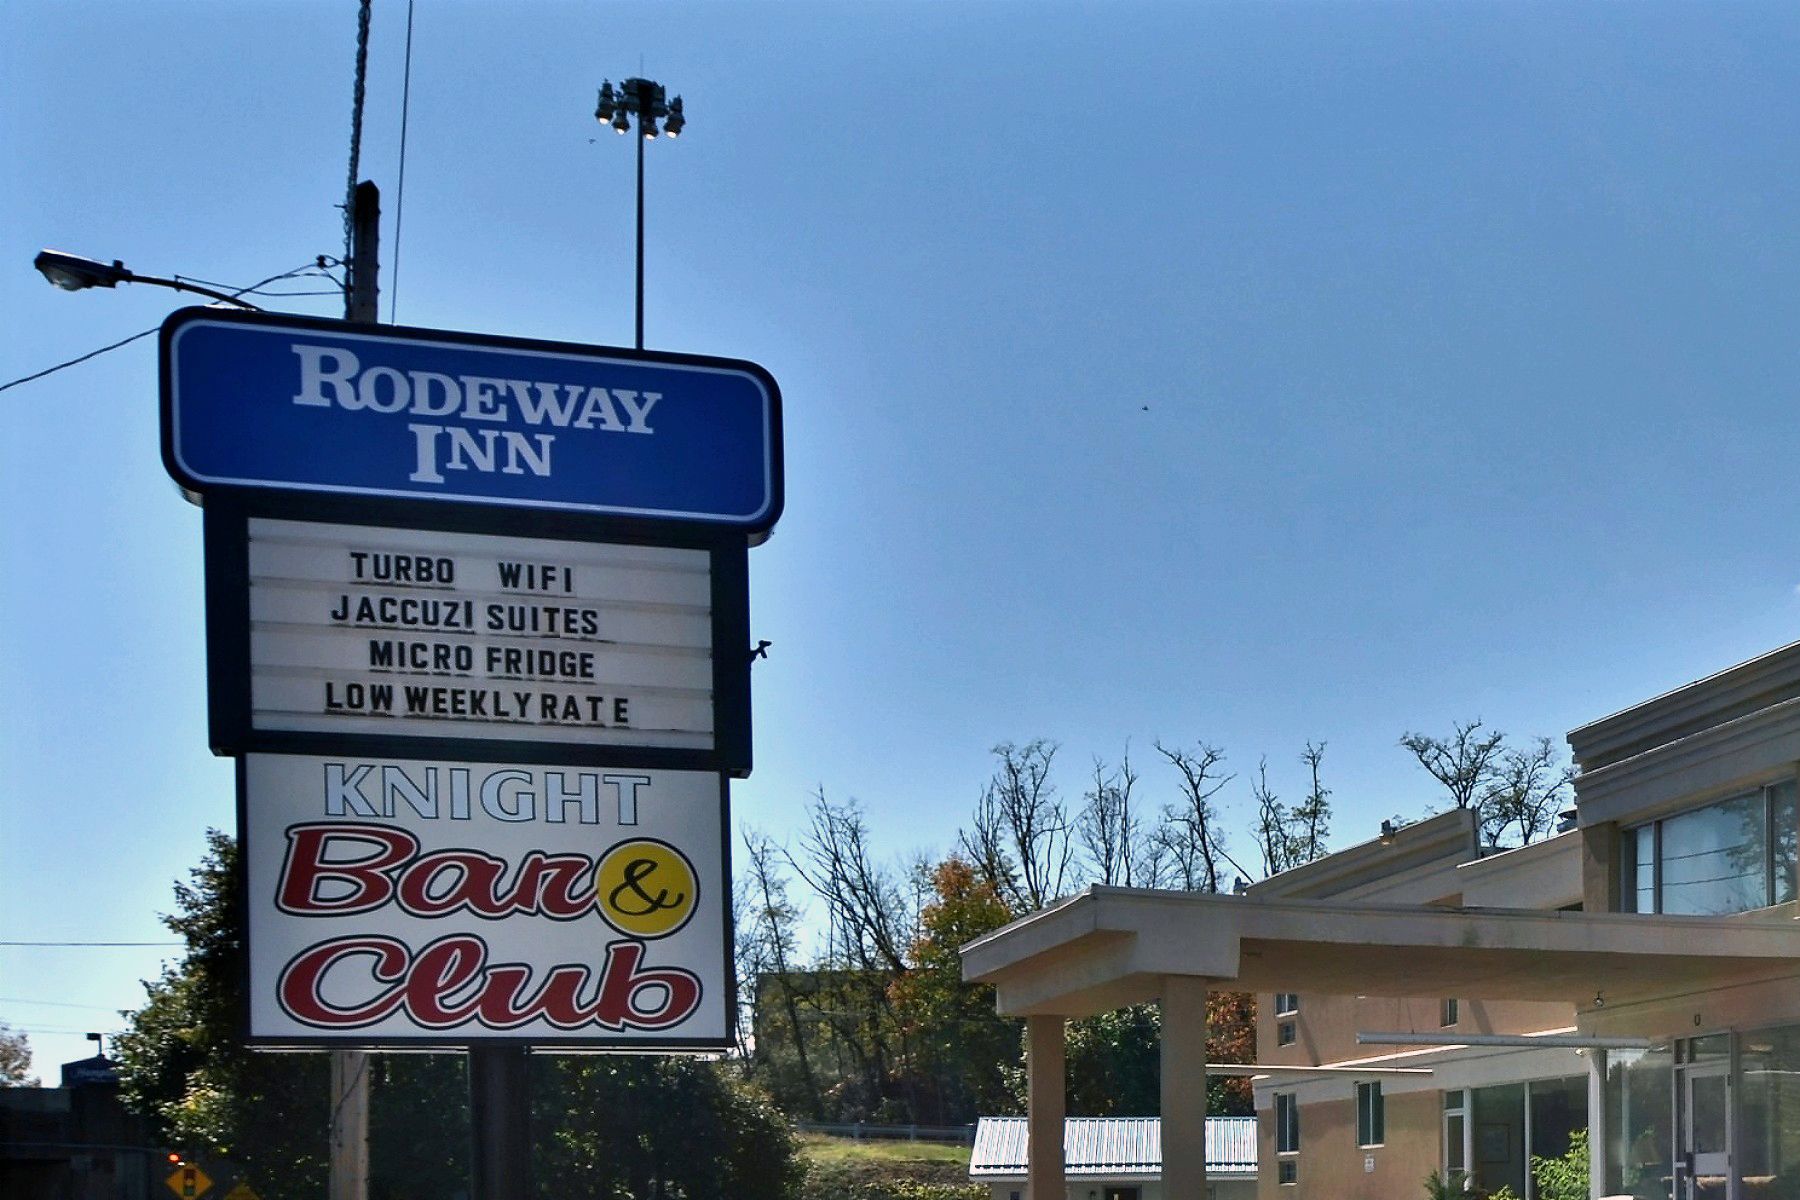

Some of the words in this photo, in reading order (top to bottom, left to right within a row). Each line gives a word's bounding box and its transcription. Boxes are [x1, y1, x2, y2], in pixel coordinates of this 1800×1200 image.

[292, 344, 662, 435] RODEWAY
[409, 423, 555, 484] INN
[350, 552, 455, 583] TURBO
[498, 562, 573, 592] WIFI
[331, 595, 473, 629] JACCUZI
[487, 603, 598, 635] SUITES
[369, 640, 473, 671] MICRO
[487, 646, 595, 678] FRIDGE
[325, 682, 393, 711] LOW
[323, 763, 652, 826] KNIGHT
[275, 821, 601, 921] Bar
[609, 858, 684, 916] &
[276, 932, 704, 1033] Club
